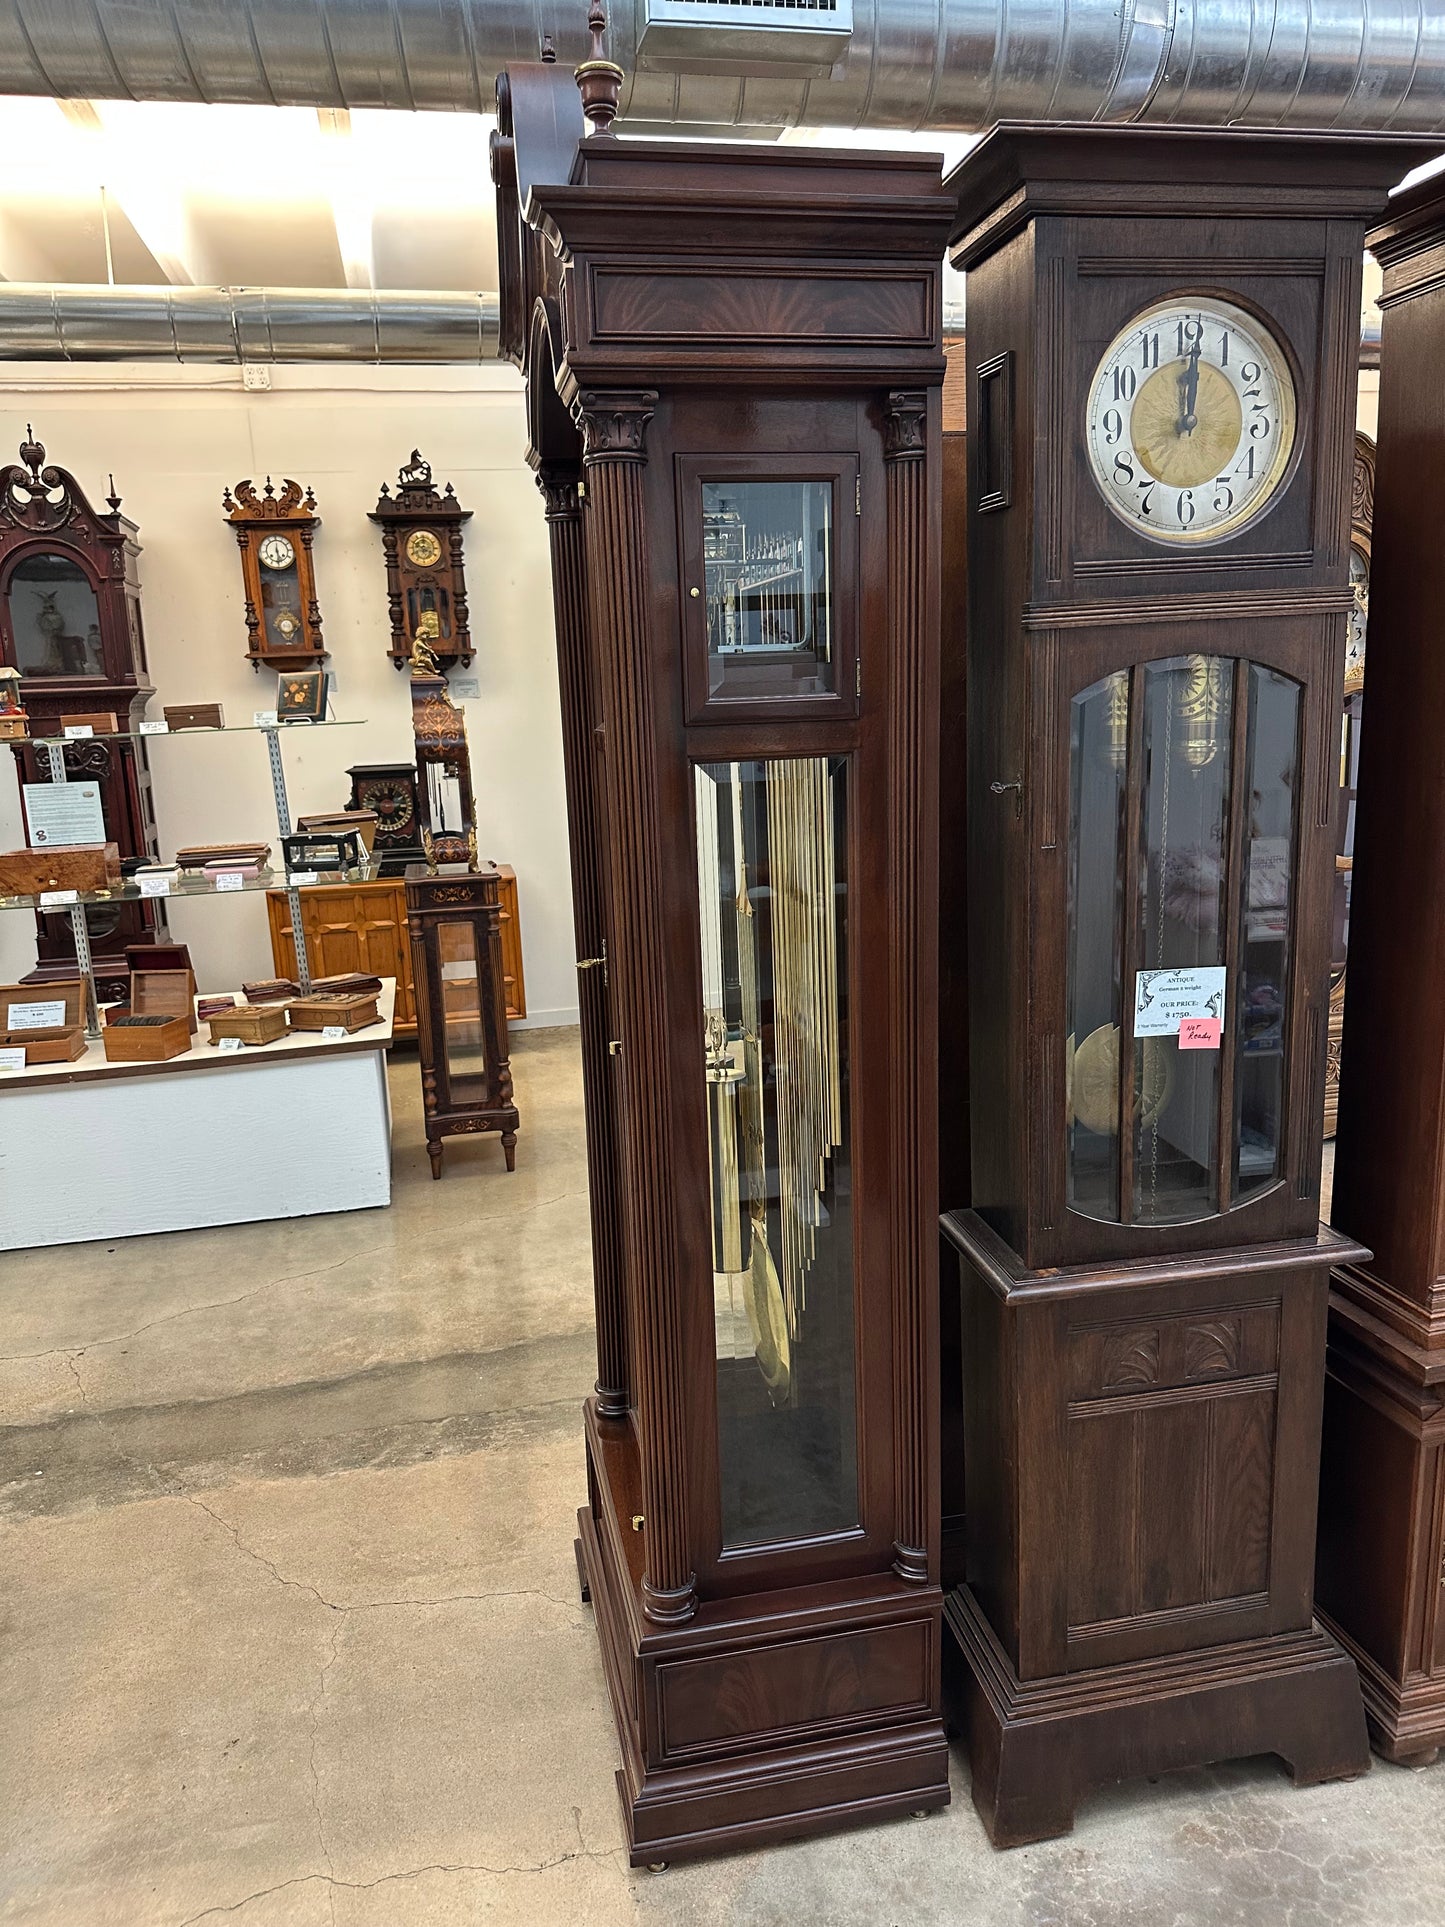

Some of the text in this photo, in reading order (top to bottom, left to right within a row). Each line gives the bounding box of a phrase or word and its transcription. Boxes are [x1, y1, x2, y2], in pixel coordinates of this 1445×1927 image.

[1138, 333, 1159, 369] 11
[1173, 320, 1204, 357] 12
[1217, 332, 1228, 368] 1
[1110, 365, 1136, 401] 10
[1241, 361, 1262, 398] 2
[1102, 408, 1123, 444] 9
[1250, 403, 1270, 439] 3
[1113, 450, 1134, 486] 8
[1234, 445, 1260, 480] 4
[1138, 479, 1156, 515] 7
[1176, 489, 1196, 524] 6
[1213, 476, 1234, 512] 5
[1351, 609, 1359, 623] 2
[1355, 627, 1363, 641] 3
[1349, 645, 1358, 658] 4
[1188, 1031, 1211, 1040] Ready
